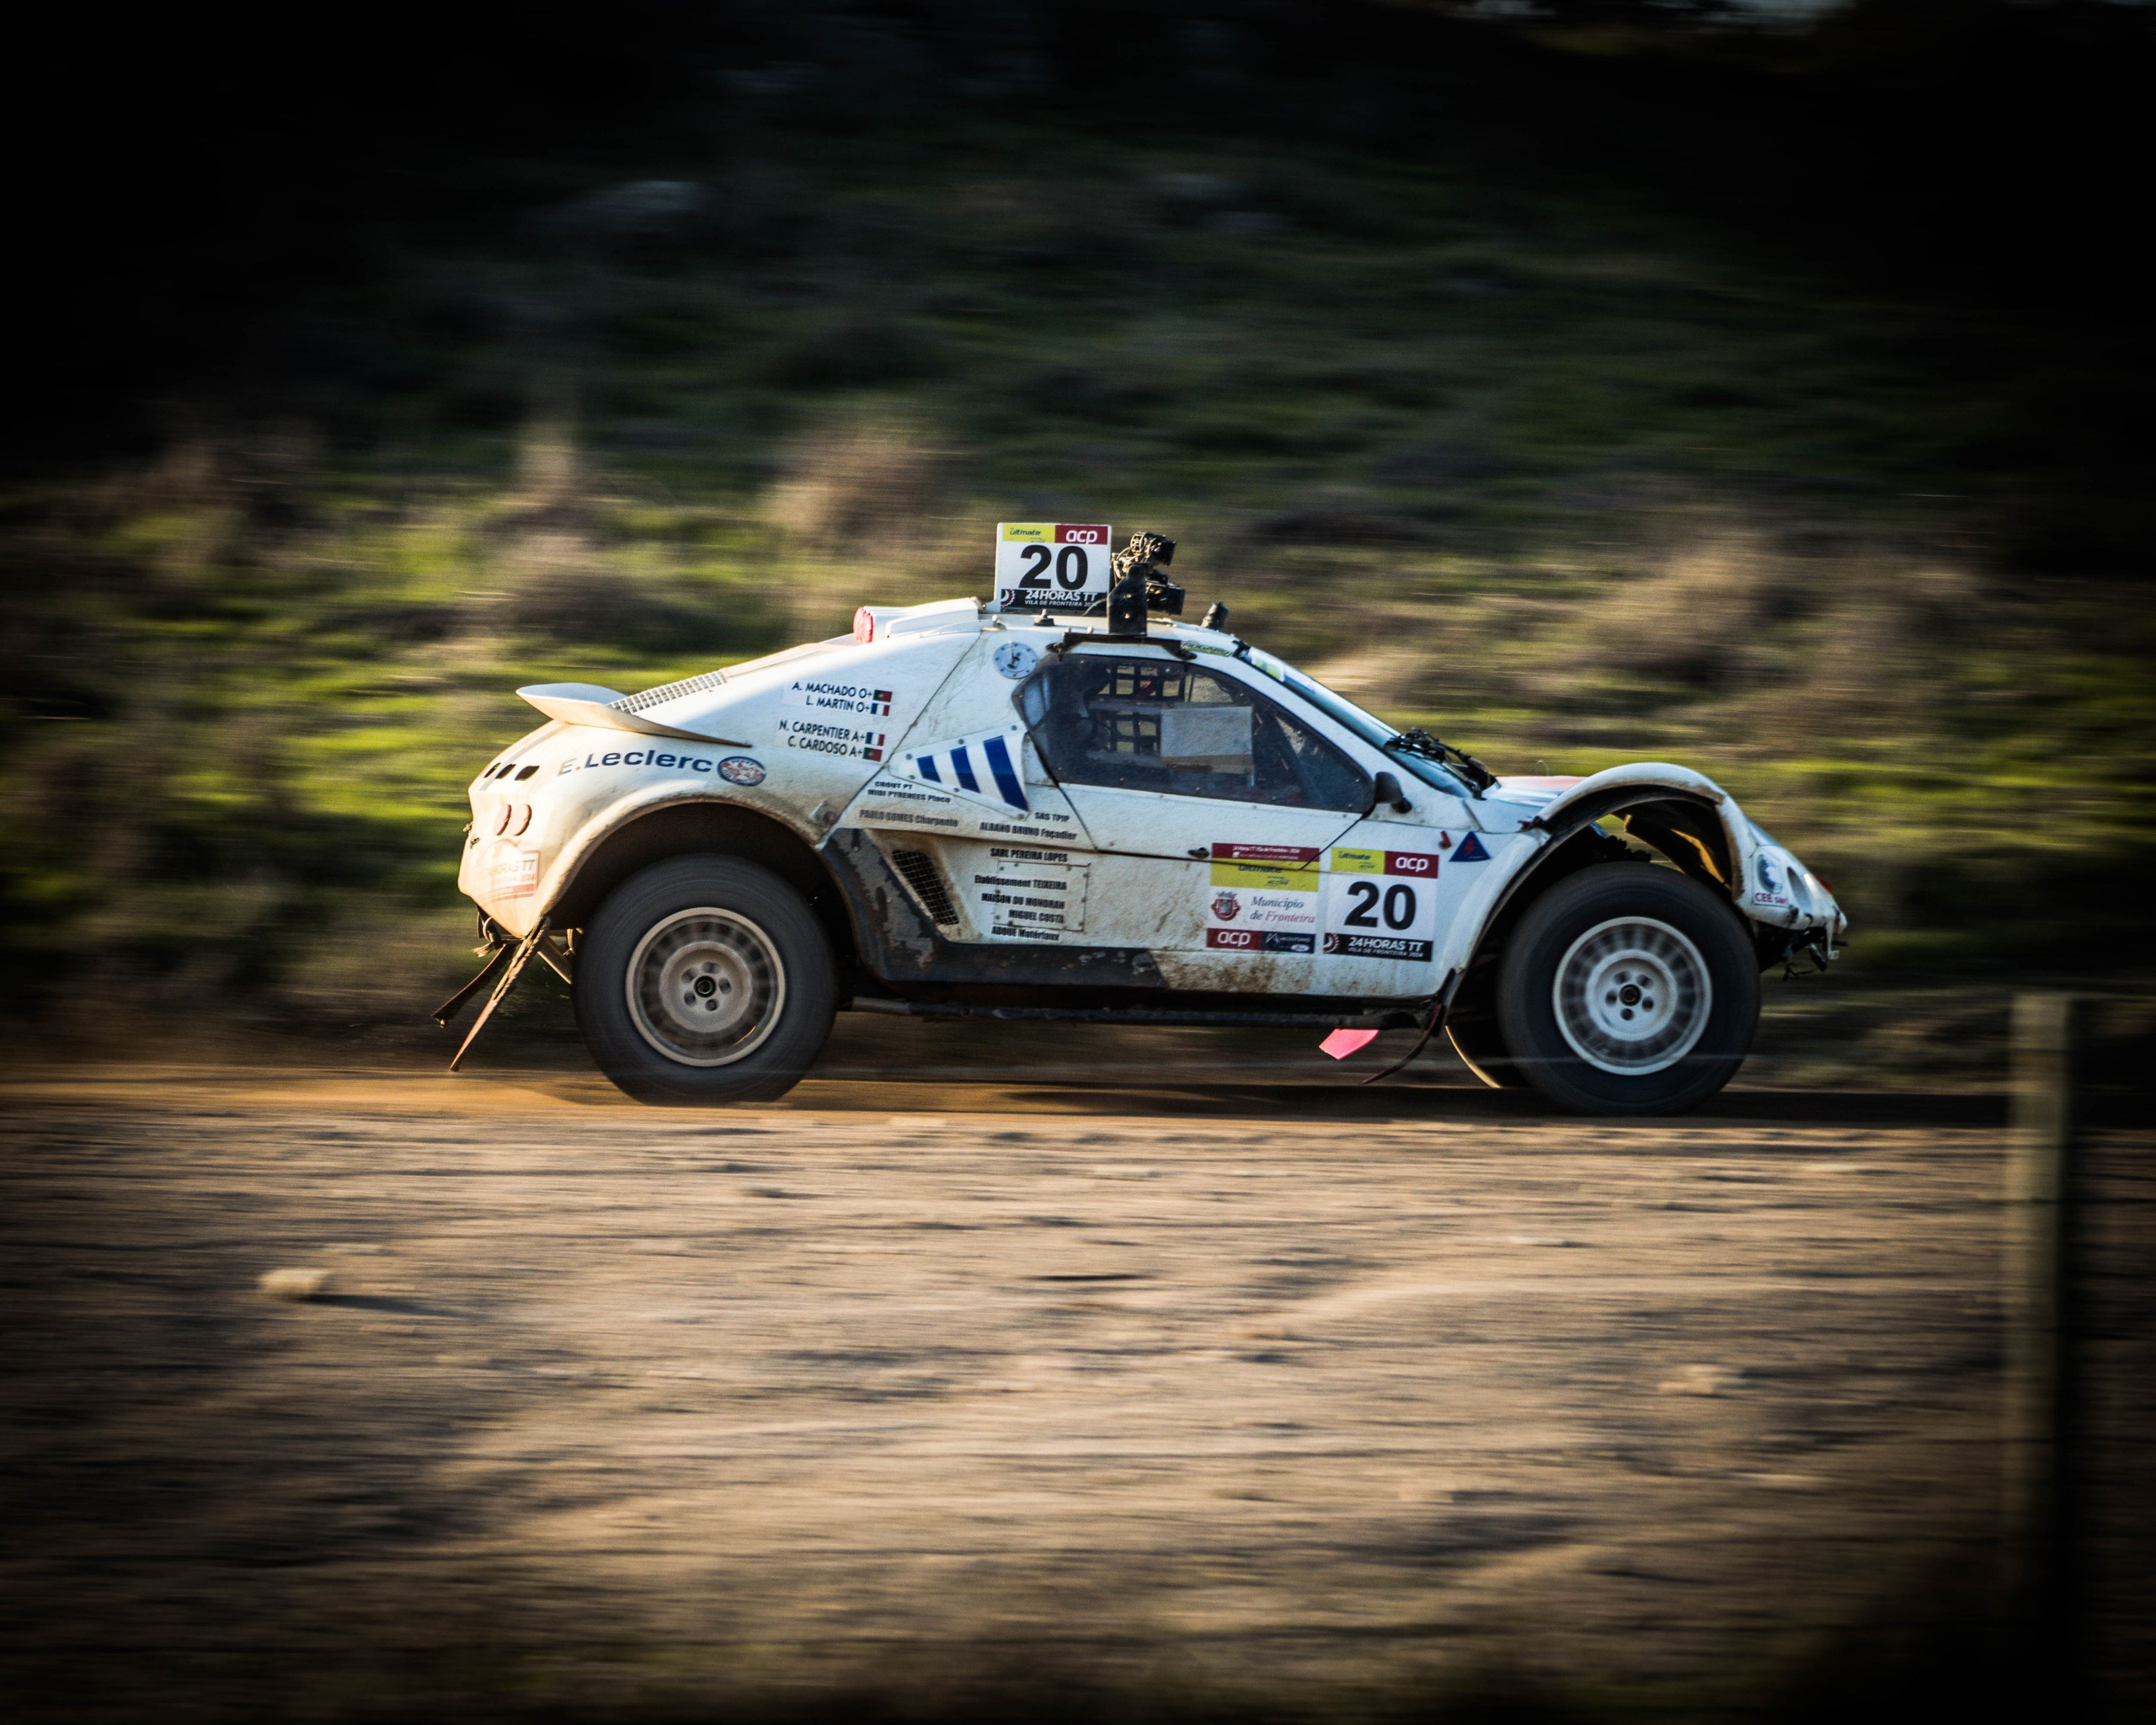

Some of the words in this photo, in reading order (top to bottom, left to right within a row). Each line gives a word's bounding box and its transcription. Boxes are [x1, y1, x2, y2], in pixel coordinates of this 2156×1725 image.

[1065, 530, 1097, 545] acp
[1018, 544, 1088, 590] 20
[1083, 592, 1097, 602] TT
[792, 681, 802, 691] A.
[805, 682, 857, 697] MACHADO
[858, 687, 873, 698] O+
[806, 695, 814, 706] L.
[816, 697, 855, 711] MARTIN
[857, 702, 870, 713] O+
[779, 719, 789, 731] N.
[792, 721, 850, 741] CARPENTIER
[851, 731, 865, 743] A+
[787, 735, 796, 747] C.
[799, 737, 848, 756] CARDOSO
[849, 746, 862, 757] A+
[888, 791, 926, 801] PYRENEES
[886, 812, 914, 823] GOMES
[915, 814, 958, 827] Charpente
[979, 822, 1011, 833] ALBANO
[1011, 825, 1040, 836] BRUNO
[1041, 828, 1077, 841] Façadier
[990, 847, 1010, 857] SARL
[1011, 849, 1043, 860] PEREIRA
[1044, 852, 1068, 862] LOPES
[1395, 857, 1429, 873] acp
[1033, 879, 1067, 890] TEIXEIRA
[981, 893, 1011, 904] MAISON
[1012, 896, 1024, 905] DU
[1251, 895, 1305, 911] Município
[1754, 893, 1774, 903] CEE
[1343, 881, 1417, 931] 20
[1008, 910, 1037, 921] MIGUEL
[1038, 912, 1065, 924] COSTA
[1249, 911, 1263, 920] de
[1265, 911, 1315, 924] Fronteira
[1217, 931, 1251, 947] acp
[1407, 941, 1424, 952] TT
